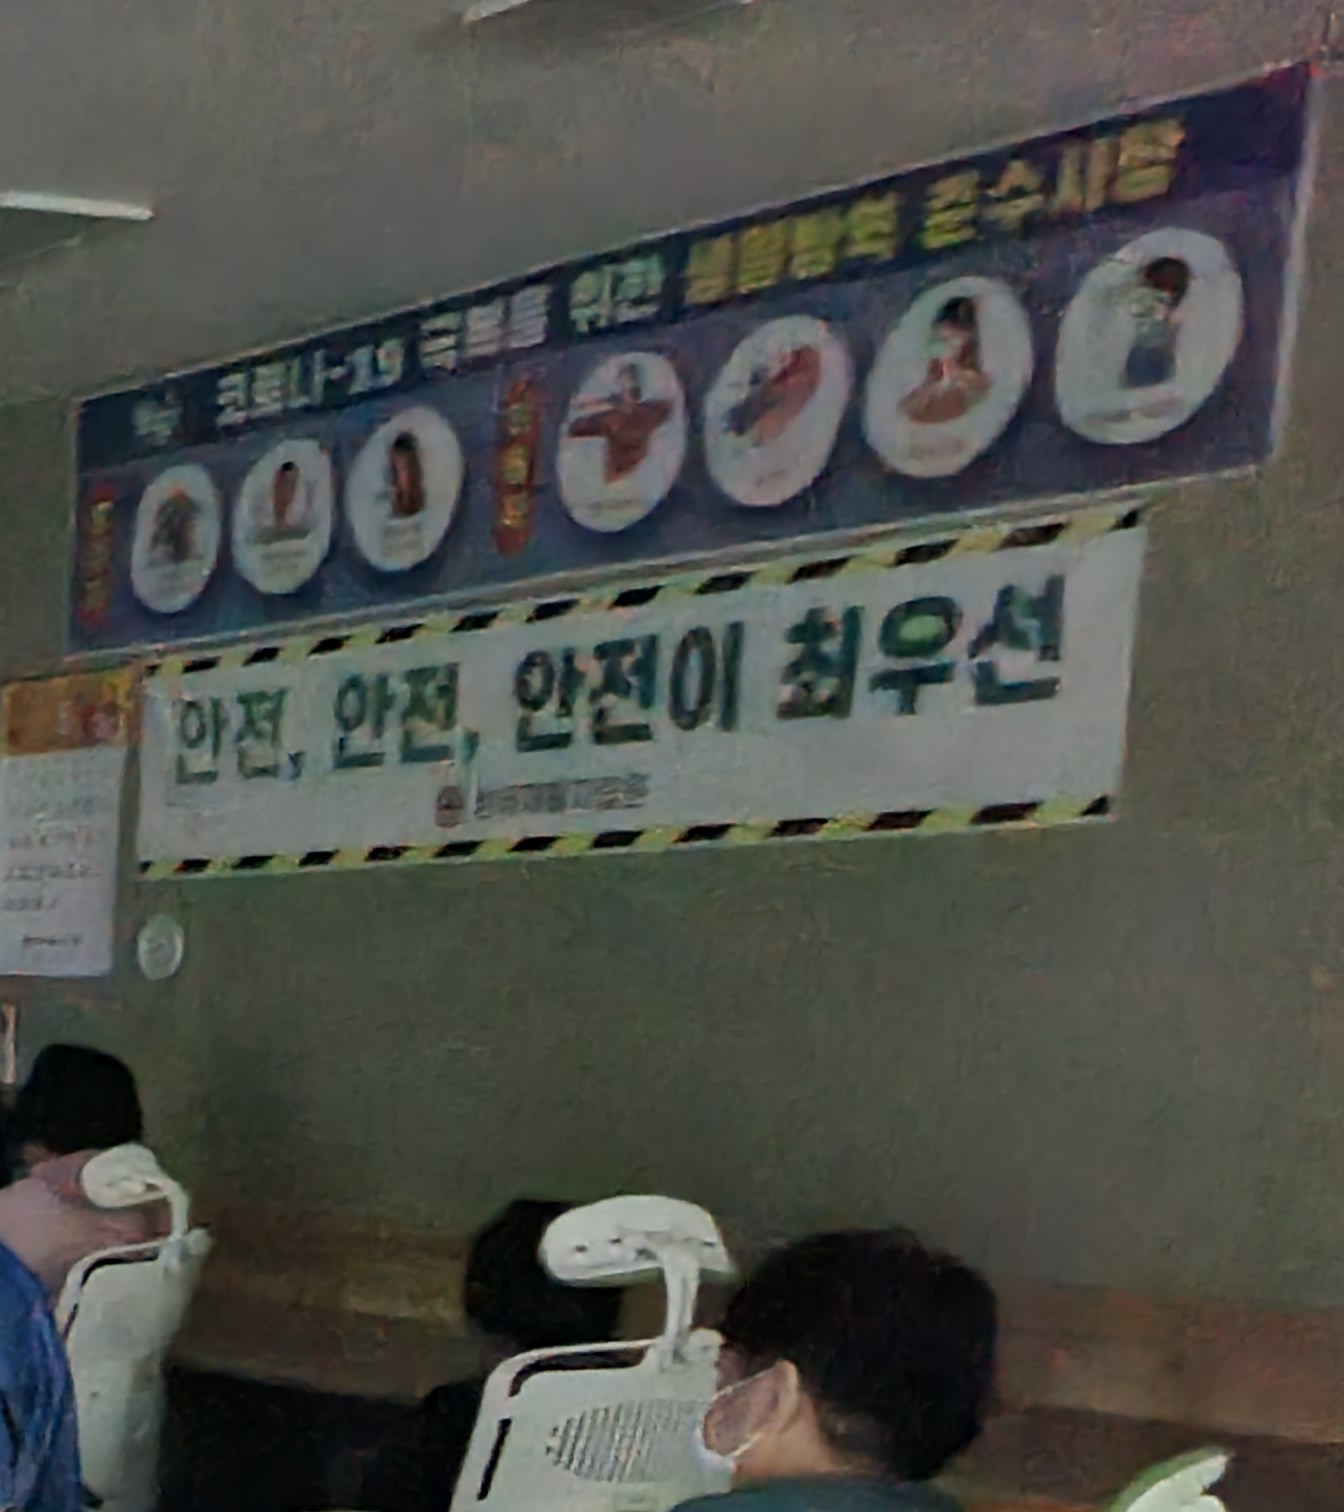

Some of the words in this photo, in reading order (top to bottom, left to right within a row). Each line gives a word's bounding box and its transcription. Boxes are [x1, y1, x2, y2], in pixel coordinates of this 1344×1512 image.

[174, 686, 305, 785] 안전,
[333, 662, 481, 769] 안전,
[514, 620, 745, 752] 안전이
[776, 572, 1066, 720] 최우선
